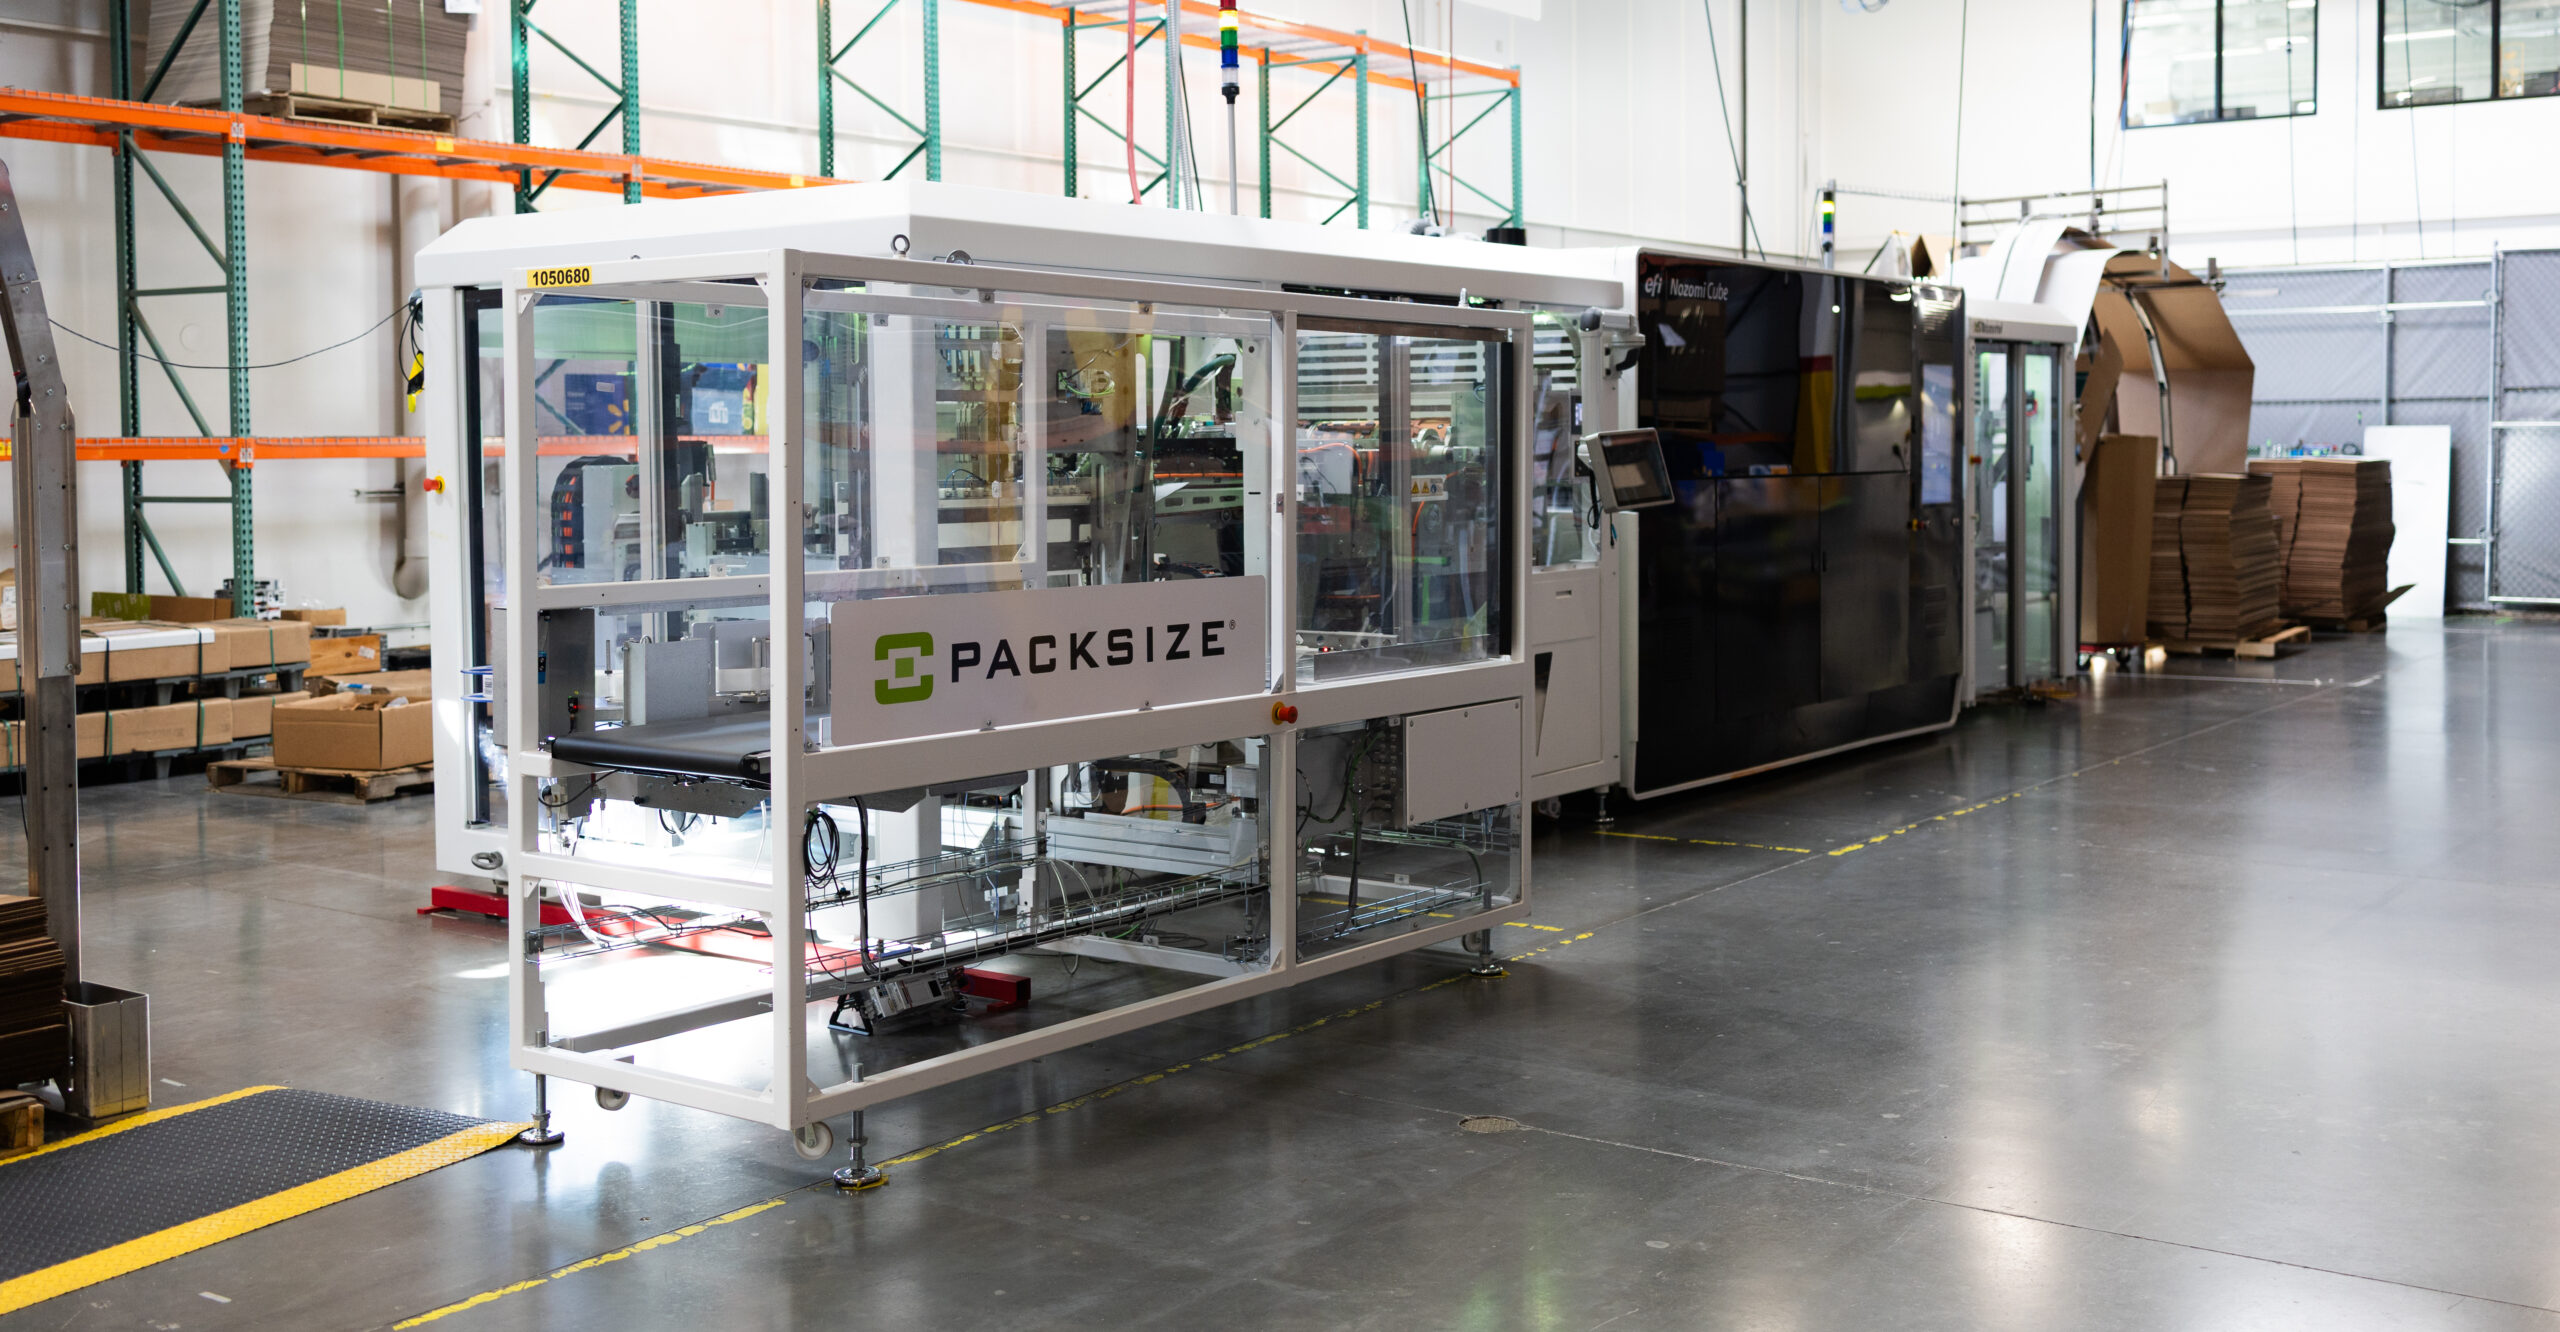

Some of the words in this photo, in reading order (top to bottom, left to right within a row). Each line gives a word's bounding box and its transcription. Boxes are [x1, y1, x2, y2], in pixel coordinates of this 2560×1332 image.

[532, 268, 590, 286] 1050680
[1644, 273, 1662, 297] efi
[1669, 278, 1706, 298] Nozomi
[1707, 282, 1729, 301] Cube
